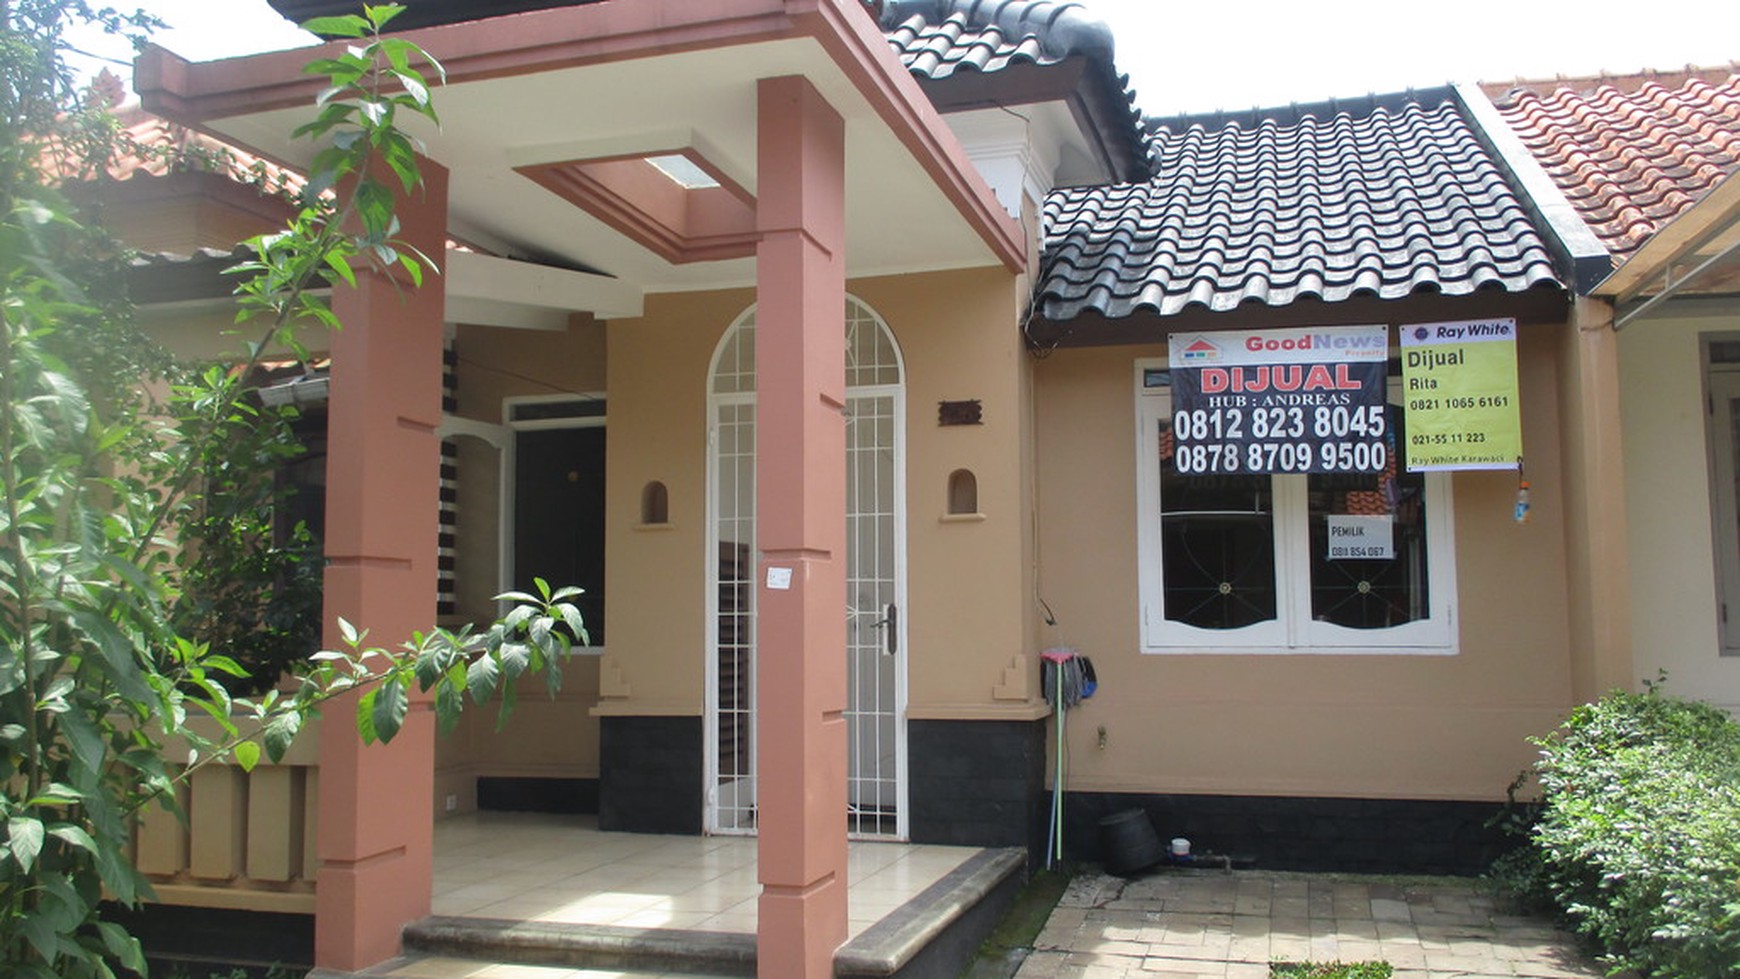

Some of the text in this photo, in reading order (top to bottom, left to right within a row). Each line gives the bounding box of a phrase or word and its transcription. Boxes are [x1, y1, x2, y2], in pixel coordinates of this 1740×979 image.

[1437, 324, 1509, 339] Ray White
[1245, 335, 1386, 351] GoodNews
[1408, 349, 1464, 370] Dijual
[1201, 364, 1362, 393] DIJUAL
[1410, 378, 1438, 390] Rita
[1209, 395, 1247, 408] HUB
[1262, 393, 1351, 406] ANDREAS
[1410, 396, 1508, 410] 0821 1065 6161
[1175, 405, 1385, 440] 0812 823 8045
[1412, 432, 1486, 445] 021-55 11 223
[1176, 441, 1386, 473] 0878 8709 9500
[1411, 453, 1505, 467] Ray White Karawaci
[1331, 526, 1365, 537] PEMILIK
